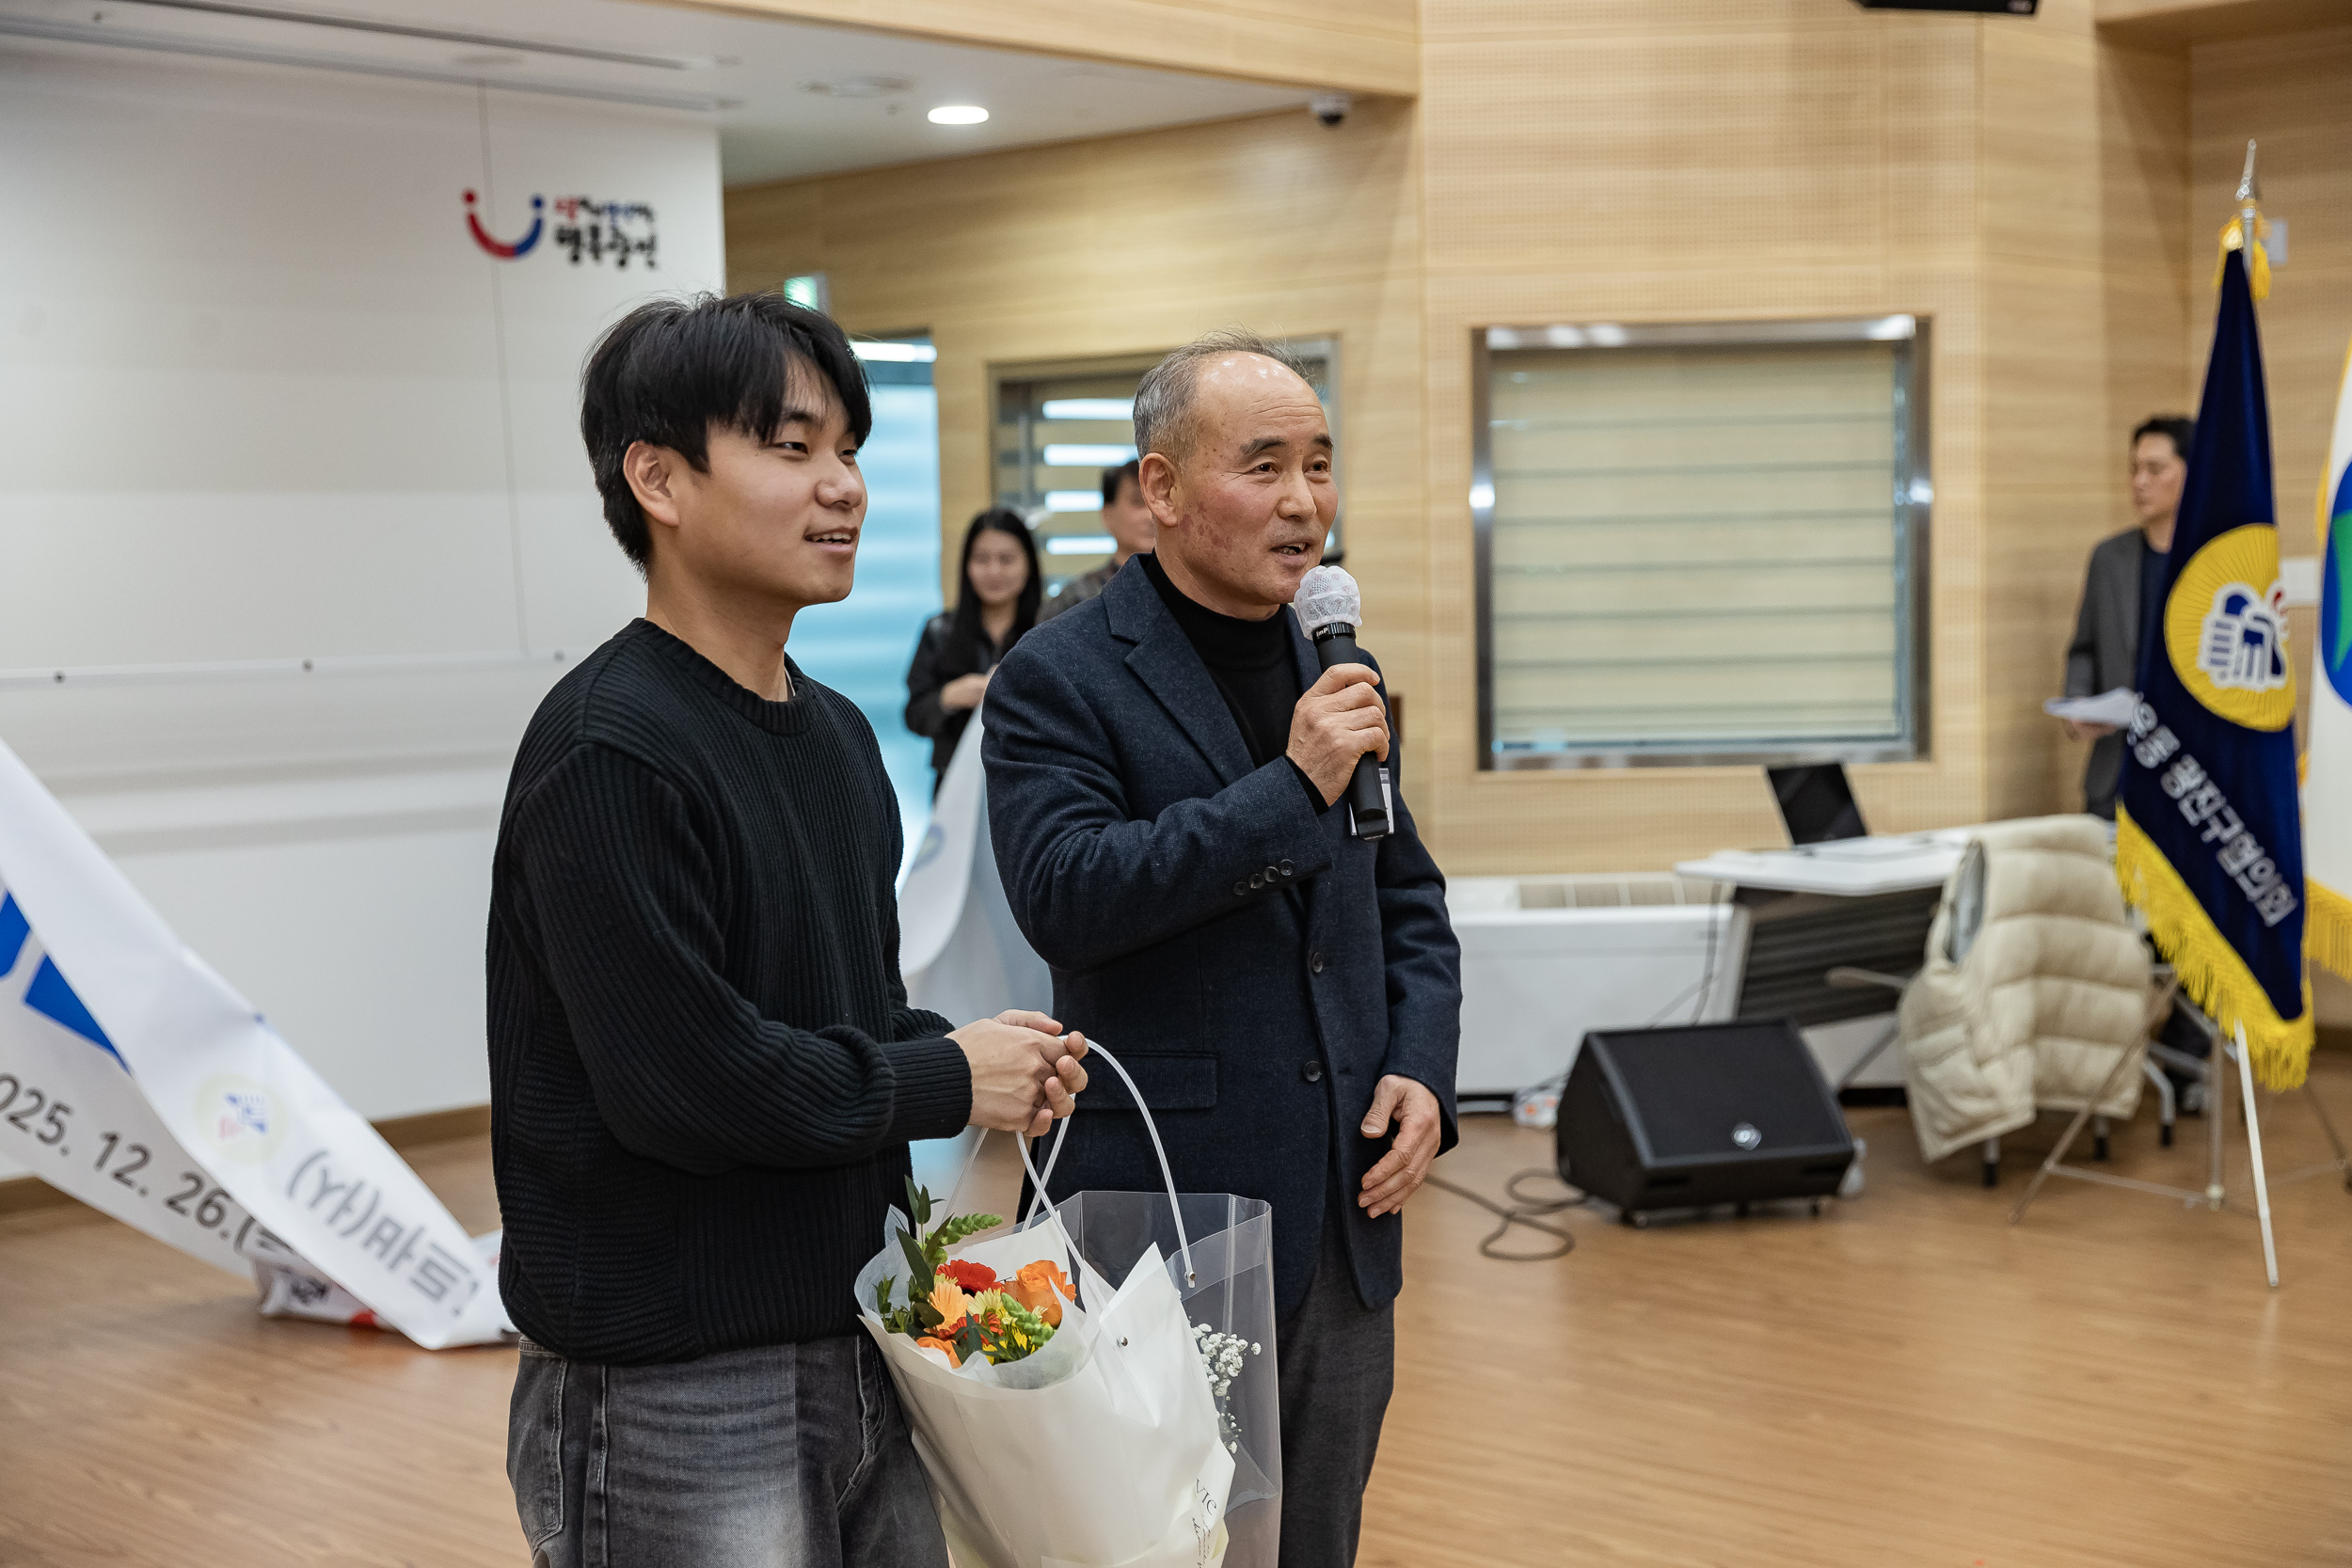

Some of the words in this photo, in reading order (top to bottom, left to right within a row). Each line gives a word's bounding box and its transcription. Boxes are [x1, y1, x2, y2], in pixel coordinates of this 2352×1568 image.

[2126, 693, 2182, 769] 운동
[2159, 752, 2299, 927] 광진구협의회
[94, 1131, 152, 1197] 12.
